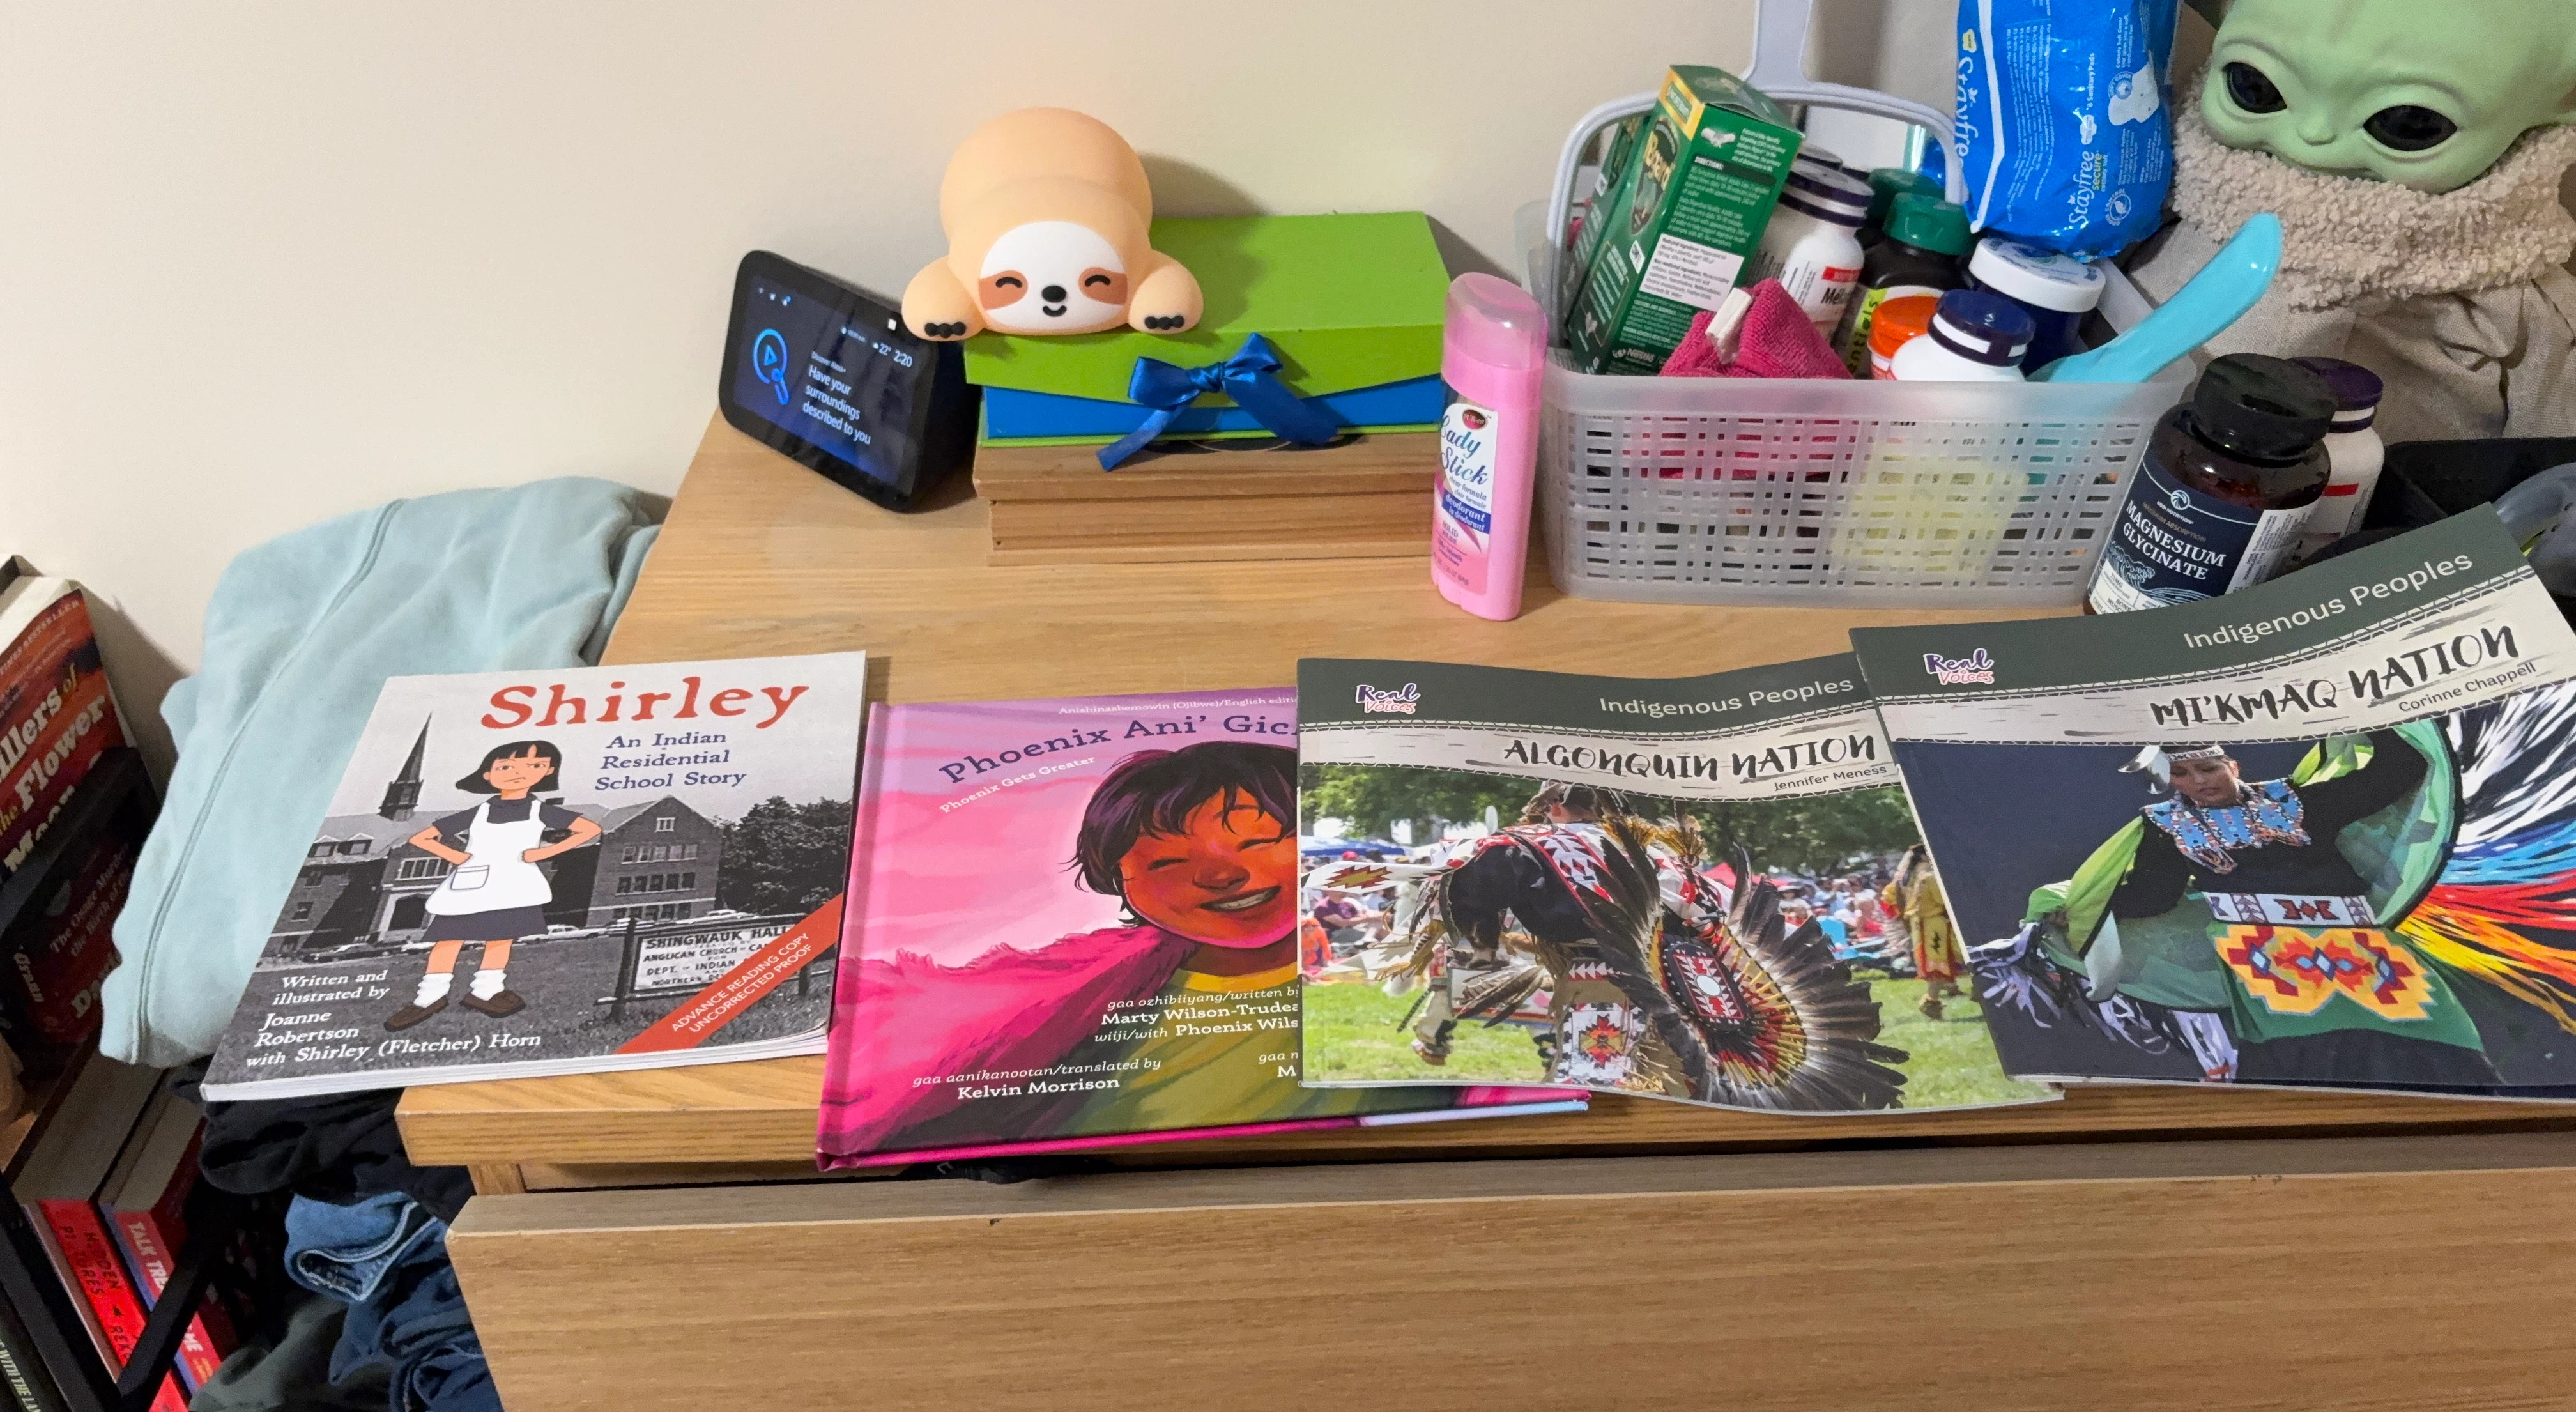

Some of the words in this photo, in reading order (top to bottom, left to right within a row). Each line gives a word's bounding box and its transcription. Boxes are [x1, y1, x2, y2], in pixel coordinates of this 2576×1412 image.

[2068, 151, 2095, 224] Stayfree
[893, 349, 913, 368] 2:20
[808, 364, 831, 386] Have
[831, 378, 852, 395] your
[805, 384, 861, 421] surroundings
[802, 401, 844, 431] described
[844, 422, 854, 436] to
[853, 429, 871, 445] you
[1440, 415, 1482, 459] Lady
[1441, 446, 1488, 486] Stick
[1462, 484, 1487, 501] formula
[1445, 493, 1486, 523] deodorant
[2126, 499, 2227, 567] MAGNESIUM
[2123, 522, 2209, 580] GLYCINATE
[2182, 597, 2347, 650] Indigenous
[2348, 553, 2474, 611] Peoples
[1924, 647, 1992, 673] Real
[2347, 624, 2520, 704] NATION
[1936, 667, 1995, 686] Voices
[2397, 682, 2464, 714] Corinne
[2462, 661, 2537, 699] Chappell
[480, 676, 810, 729] Shirley
[1355, 682, 1420, 703] Real
[1363, 699, 1417, 714] Voices
[1598, 696, 1743, 720] Indigenous
[1748, 677, 1855, 707] Peoples
[1058, 702, 1170, 715] Anishinaabemowin
[14, 694, 106, 813] Flower
[606, 735, 641, 749] An
[651, 732, 727, 747] Indian
[939, 728, 1113, 784] Phoenix
[1222, 714, 1298, 735] Gic
[599, 749, 730, 770] Residential
[1503, 739, 1719, 782] ALGONQUIN
[1731, 733, 1876, 779] NATION
[595, 773, 673, 791] School
[683, 772, 747, 788] Story
[939, 786, 1000, 814] Phoenix
[1000, 771, 1037, 788] Gets
[1039, 755, 1096, 779] Greater
[1773, 773, 1832, 793] Jennifer
[1833, 765, 1888, 781] Meness
[642, 950, 696, 962] ANGLICAN
[699, 946, 737, 956] CHURCH
[645, 930, 742, 949] SHINGWAUK
[282, 974, 349, 988] Written
[355, 970, 388, 983] and
[646, 965, 678, 976] DEPT.
[695, 960, 735, 971] INDIAN
[671, 989, 729, 1032] ADVANCE
[726, 955, 779, 992] READING
[777, 932, 809, 956] COPY
[271, 986, 363, 1006] illustrated
[368, 984, 390, 1001] by
[689, 971, 775, 1034] UNCORRECTED
[773, 943, 813, 973] PROOF
[1106, 999, 1136, 1011] gaa
[1138, 988, 1284, 1009] ozhibiiyang/written
[258, 1011, 332, 1032] Joanne
[1094, 1026, 1169, 1043] wiiji/with
[1175, 1020, 1254, 1038] Phoenix
[1101, 1010, 1160, 1026] Marty
[245, 1054, 286, 1068] with
[293, 1045, 369, 1063] Shirley
[378, 1034, 482, 1057] (Fletcher)
[487, 1033, 542, 1048] Horn
[254, 1027, 360, 1048] Robertson
[912, 1075, 942, 1088] gaa
[946, 1059, 1139, 1085] aanikanootan/translated
[1142, 1057, 1162, 1072] by
[1258, 1052, 1287, 1065] gaa
[957, 1082, 1022, 1100] Kelvin
[1027, 1077, 1120, 1095] Morrison
[128, 1221, 158, 1257] TALK
